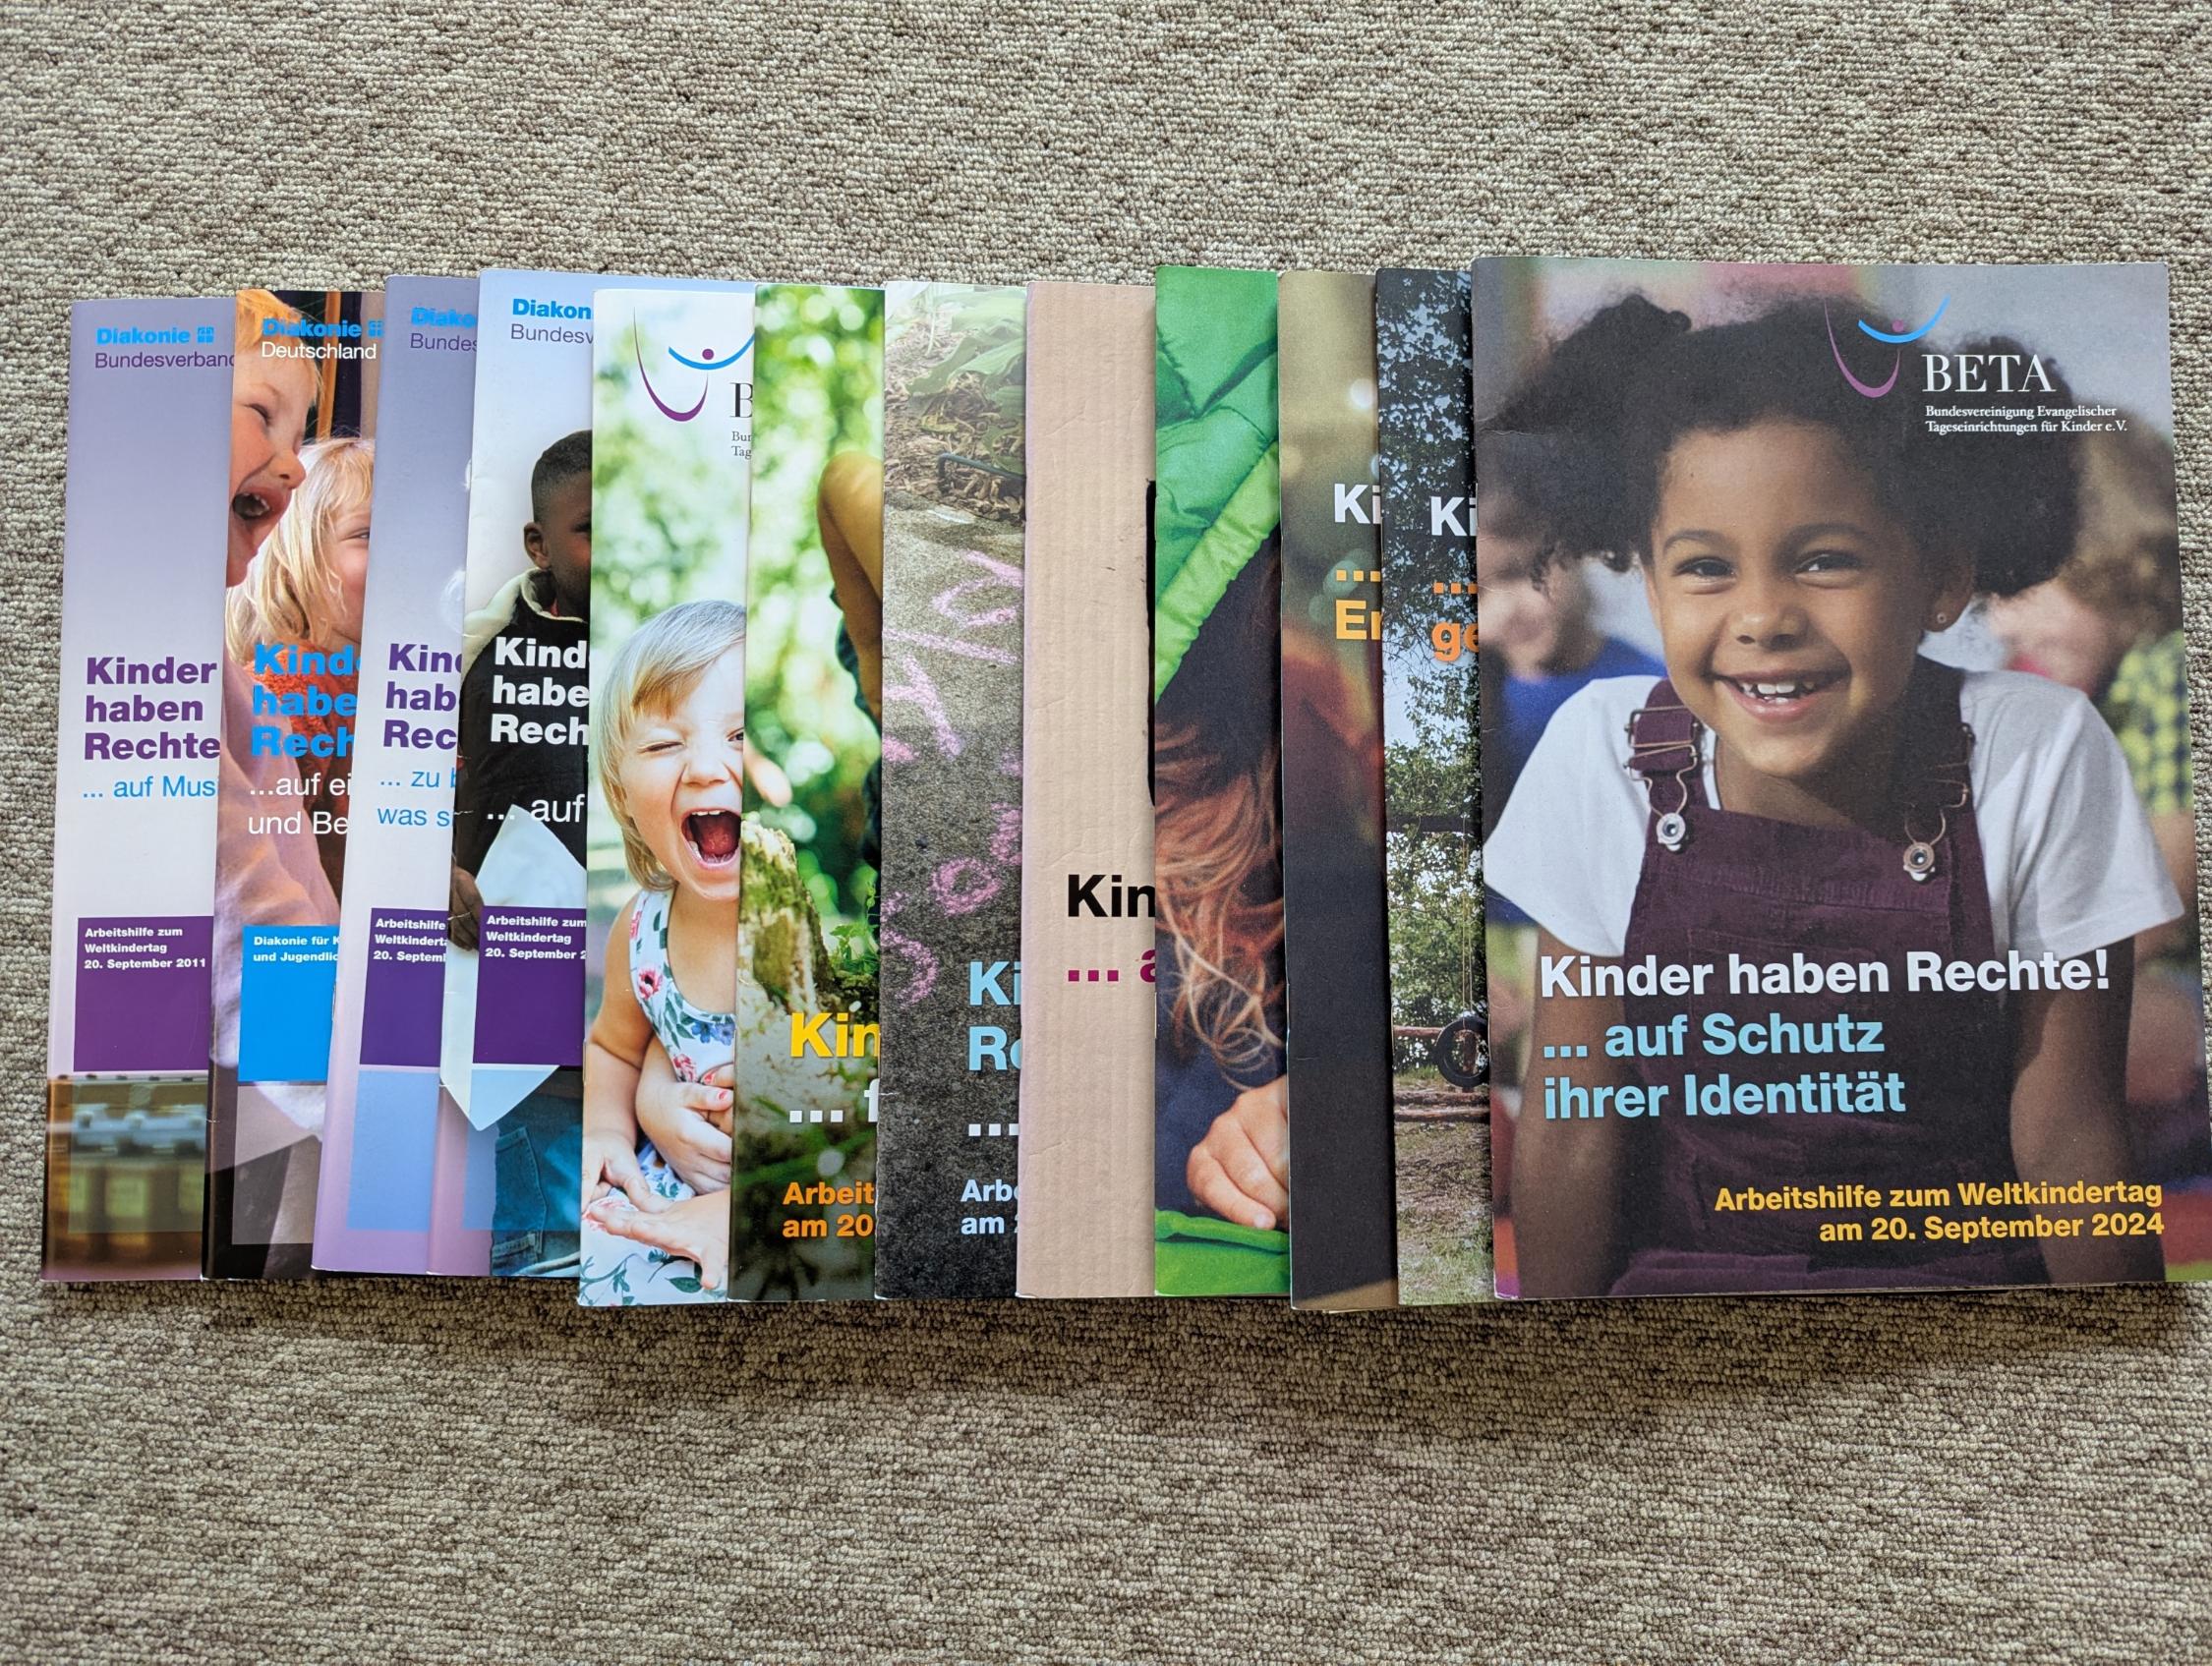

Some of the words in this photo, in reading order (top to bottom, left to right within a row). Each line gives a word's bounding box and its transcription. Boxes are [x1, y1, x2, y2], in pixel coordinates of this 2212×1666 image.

[512, 298, 591, 319] Diakon
[95, 326, 191, 345] Diakonie
[262, 318, 362, 338] Diakonie
[262, 341, 377, 360] Deutschland
[1921, 354, 2056, 393] BETA
[1925, 405, 2034, 420] Bundesvereinigung
[2036, 405, 2117, 420] Evangelischer
[1925, 421, 2038, 436] Tageseinrichtungen
[2040, 420, 2058, 432] für
[2061, 420, 2103, 432] Kinder
[2105, 420, 2127, 432] e.V.
[730, 445, 752, 460] Tag
[254, 642, 360, 675] Kind
[495, 636, 590, 669] Kind
[87, 657, 217, 685] Kinder
[252, 684, 358, 717] habe
[385, 681, 457, 712] hab
[493, 674, 590, 708] habe
[86, 694, 204, 722] haben
[251, 725, 354, 758] Rech
[382, 719, 457, 750] Rec
[491, 713, 590, 746] Rech
[85, 731, 220, 761] Rechte
[113, 776, 153, 798] auf
[162, 776, 218, 798] Mus
[411, 771, 439, 788] zu
[378, 808, 428, 827] was
[530, 794, 585, 823] auf
[248, 811, 301, 835] und
[313, 811, 348, 835] Be
[1068, 874, 1156, 918] Kin
[86, 927, 154, 939] Arbeitshilfe
[157, 928, 183, 938] zum
[376, 918, 445, 931] Arbeitshilfe
[487, 915, 558, 928] Arbeitshilfe
[561, 918, 587, 928] zum
[85, 943, 168, 955] Weltkindertag
[254, 936, 308, 947] Diakonie
[312, 935, 329, 947] für
[486, 931, 571, 946] Weltkindertag
[84, 959, 102, 969] 20.
[107, 958, 172, 970] September
[176, 957, 206, 968] 2011
[254, 952, 276, 962] und
[374, 949, 393, 961] 20.
[485, 948, 505, 959] 20.
[509, 948, 576, 960] September
[1541, 954, 1714, 998] Kinder
[1728, 952, 1890, 994] haben
[1906, 949, 2110, 992] Rechte!
[790, 1012, 880, 1058] Kin
[1604, 1013, 1689, 1058] auf
[1702, 1011, 1885, 1056] Schutz
[1544, 1077, 1670, 1120] ihrer
[1685, 1070, 1906, 1116] Identität
[783, 1181, 874, 1205] Arbeit
[1715, 1184, 1882, 1211] Arbeitshilfe
[1890, 1188, 1950, 1208] zum
[1957, 1180, 2163, 1208] Weltkindertag
[783, 1219, 827, 1238] am
[836, 1214, 873, 1238] 20
[960, 1215, 1005, 1235] am
[1819, 1221, 1863, 1242] am
[1871, 1217, 1916, 1241] 20.
[1924, 1214, 2084, 1243] September
[2092, 1213, 2165, 1237] 2024
